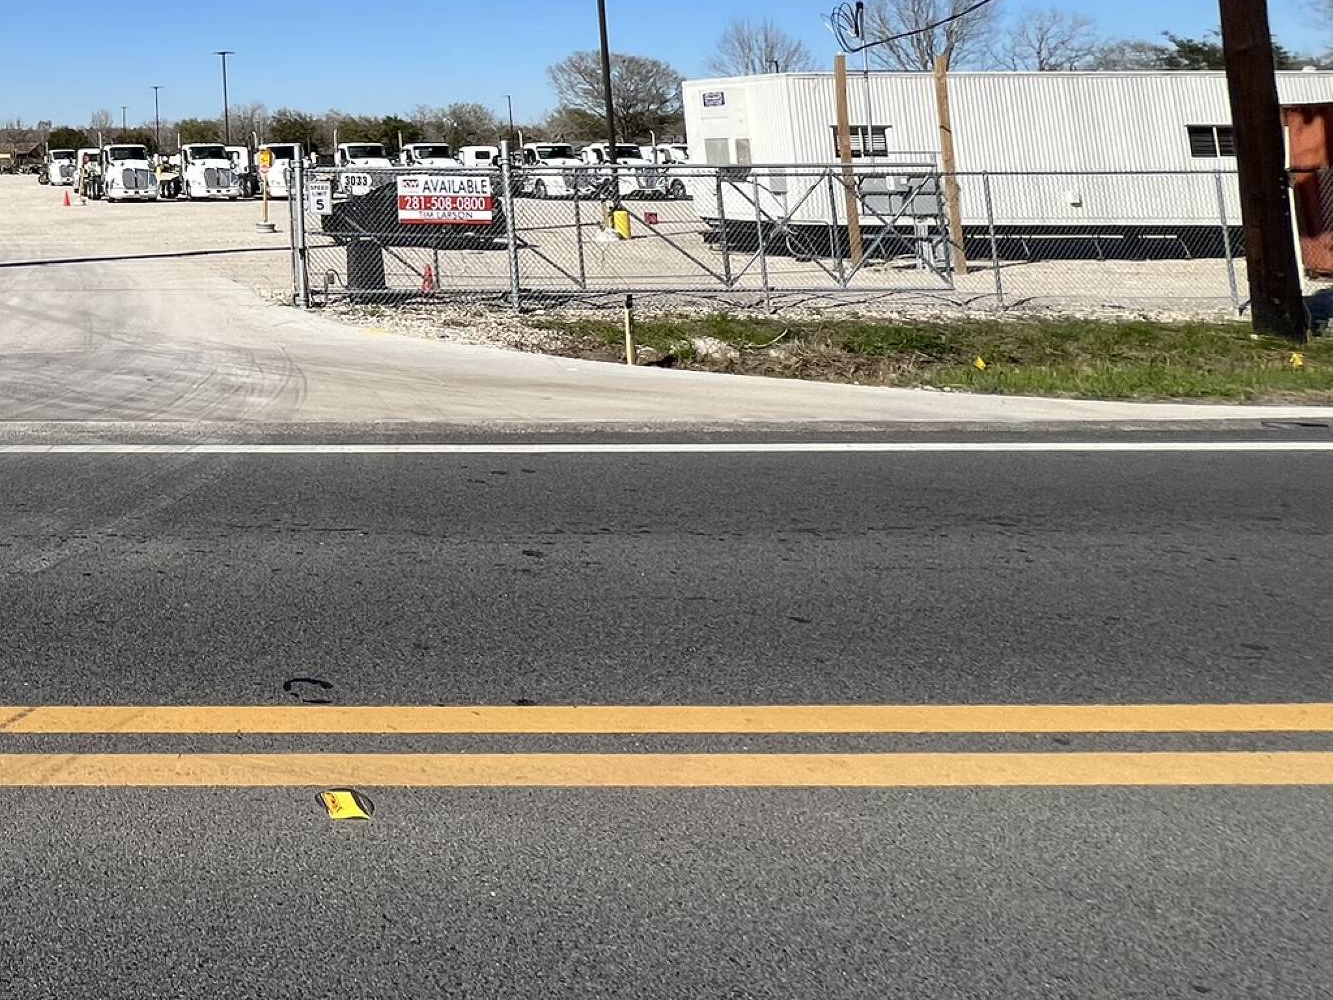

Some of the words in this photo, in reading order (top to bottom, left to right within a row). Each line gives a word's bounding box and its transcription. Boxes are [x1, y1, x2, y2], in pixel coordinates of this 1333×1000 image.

[345, 175, 368, 186] 3033
[423, 179, 488, 194] AVAILABLE
[316, 199, 325, 211] 5
[405, 197, 486, 210] 281-508-0800
[437, 211, 473, 219] LARSON
